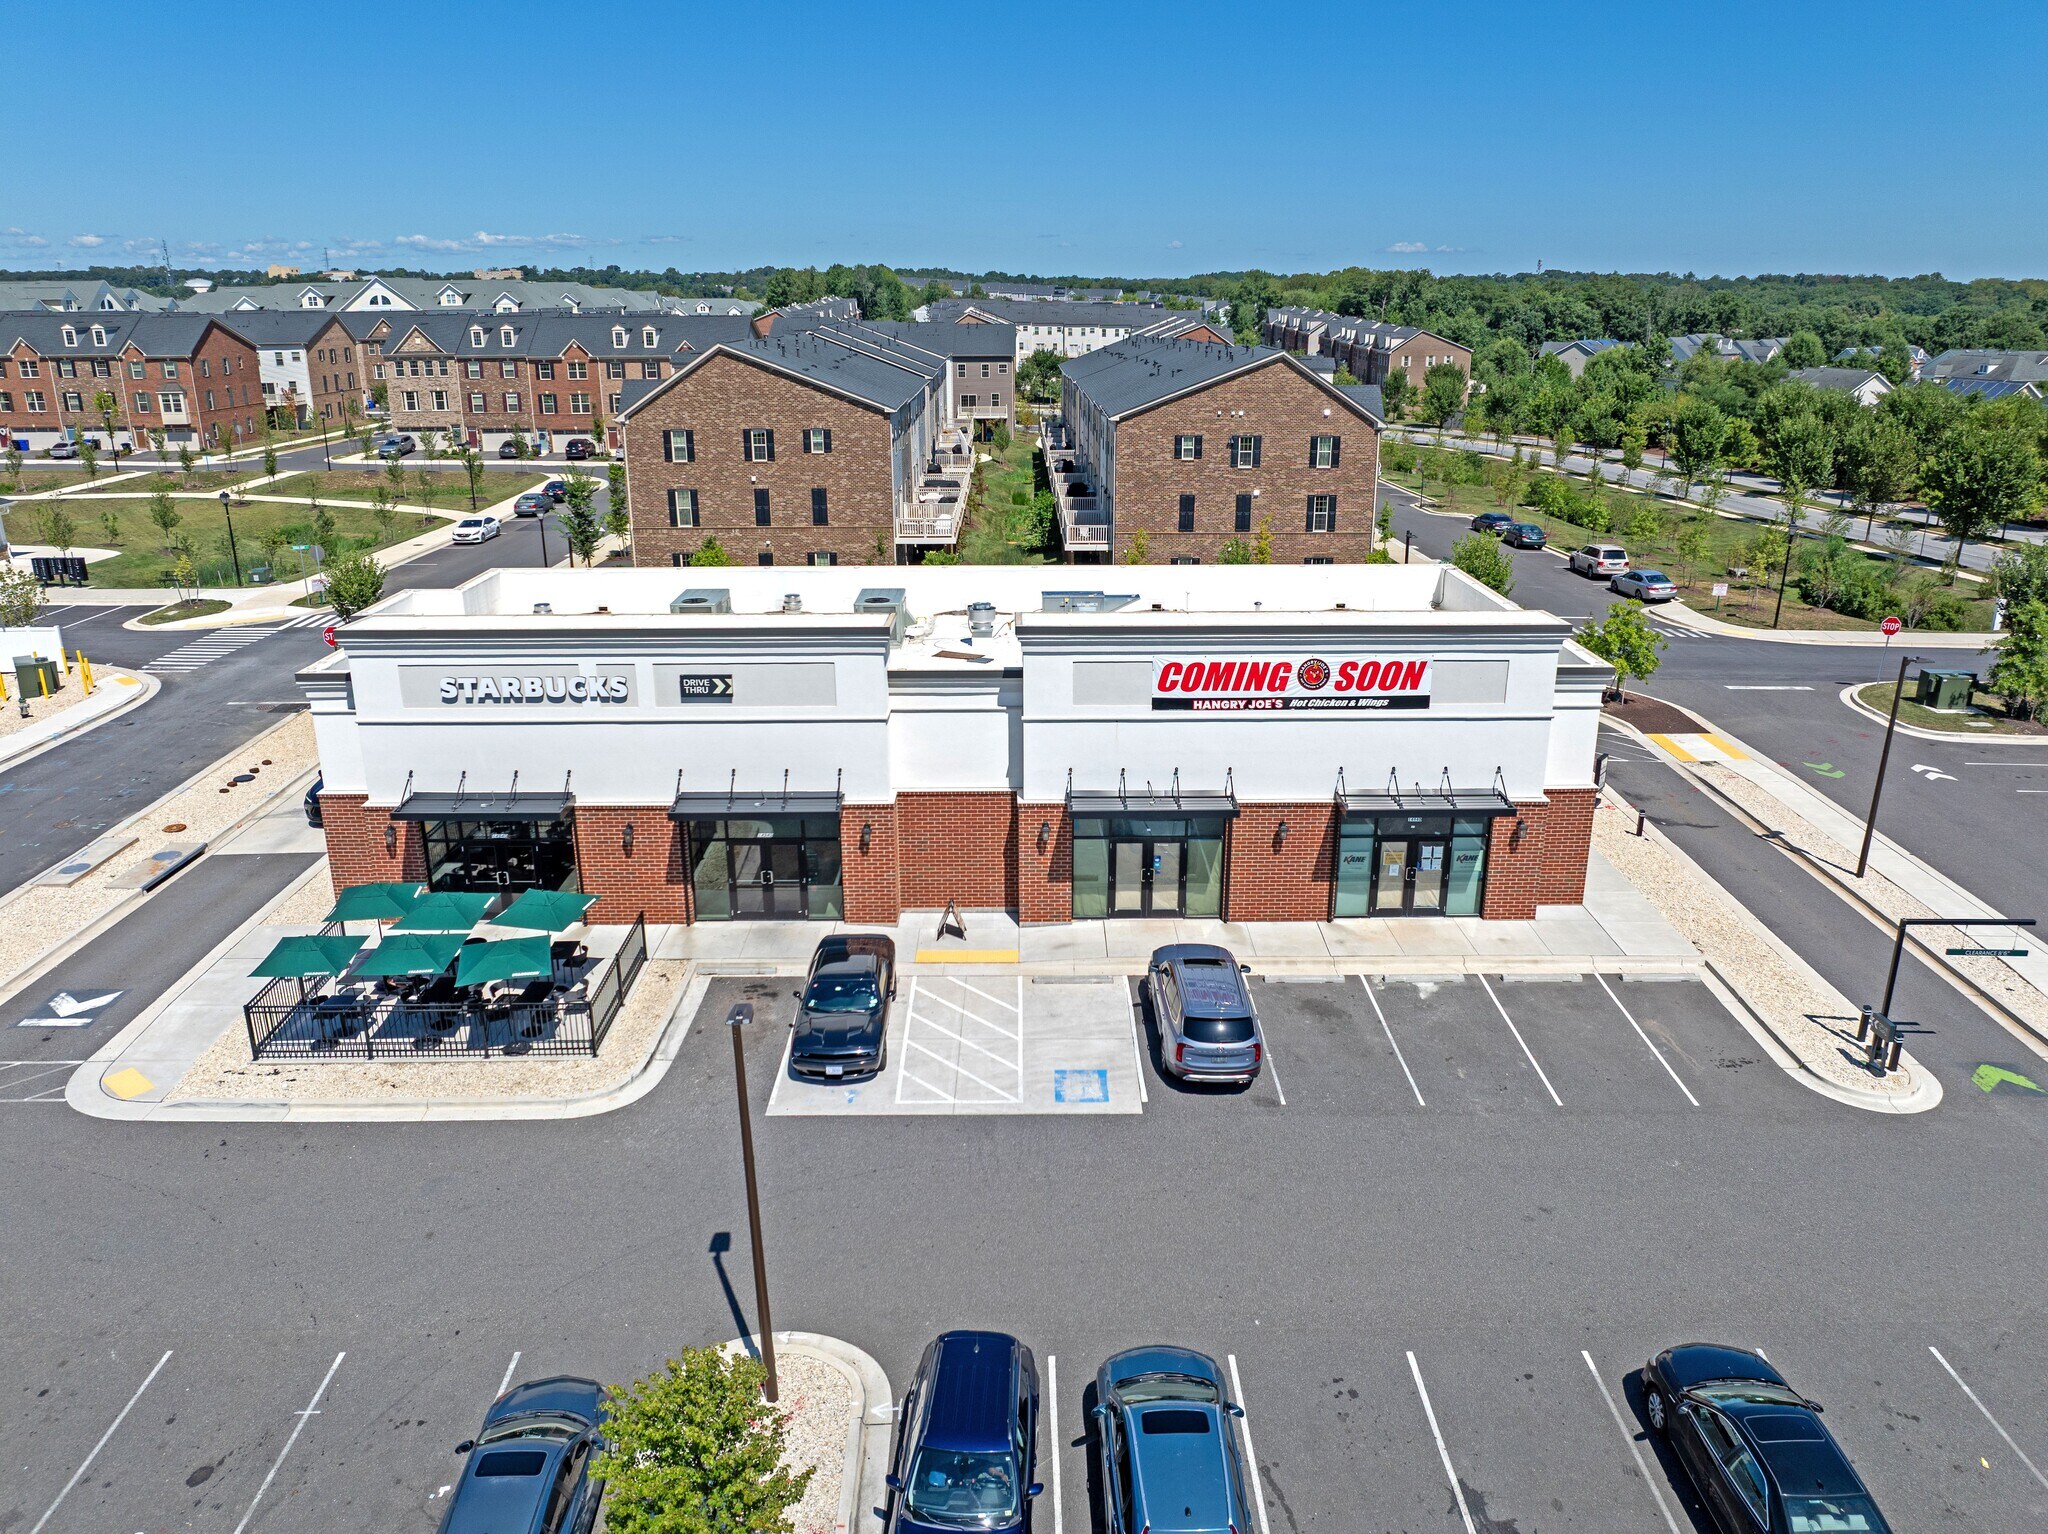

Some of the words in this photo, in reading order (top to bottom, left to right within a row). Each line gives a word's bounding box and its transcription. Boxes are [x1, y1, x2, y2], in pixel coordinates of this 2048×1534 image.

[1882, 622, 1899, 630] STOP
[1157, 661, 1292, 692] COMING
[1334, 660, 1428, 691] SOON
[683, 679, 710, 687] DRIVE
[439, 676, 629, 703] STARBUCKS
[684, 686, 709, 694] THRU
[1193, 700, 1247, 710] HANGRY
[1248, 699, 1284, 709] JOE'S
[1289, 699, 1309, 707] Hot
[1307, 698, 1349, 707] Chicken
[1357, 698, 1390, 708] Wings
[1343, 854, 1366, 864] KANE
[1456, 854, 1480, 863] KANE
